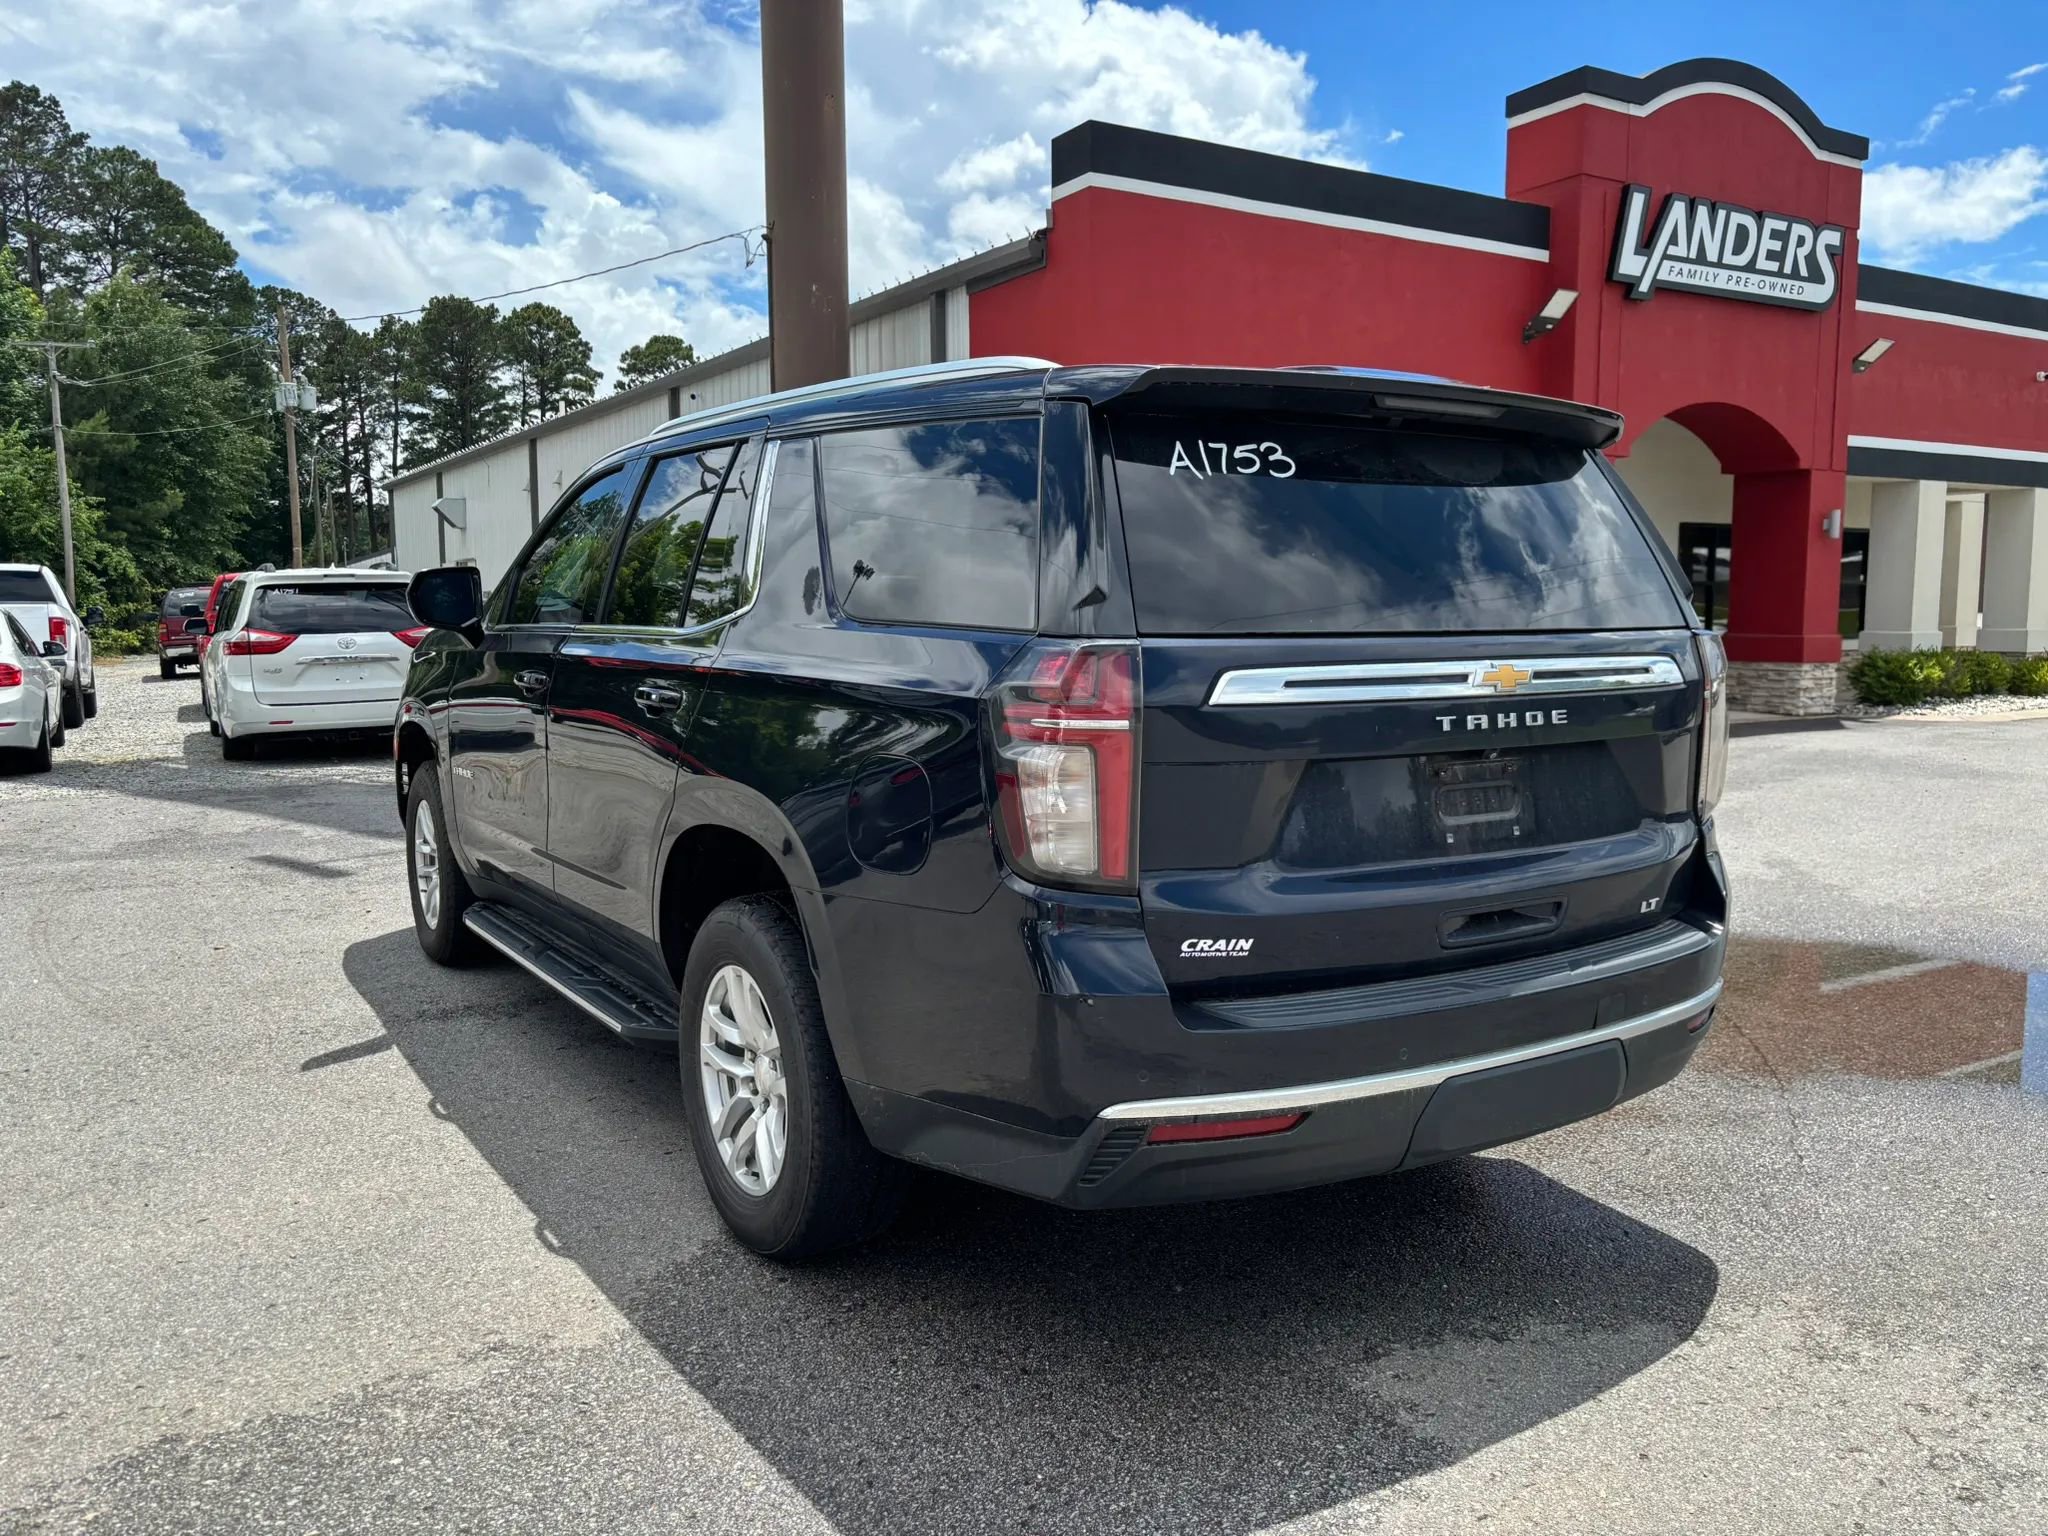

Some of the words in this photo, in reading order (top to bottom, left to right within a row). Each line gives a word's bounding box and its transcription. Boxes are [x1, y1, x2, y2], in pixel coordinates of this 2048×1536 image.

[1618, 191, 1841, 300] LANDERS
[1667, 264, 1720, 284] FAMILY
[1726, 274, 1805, 296] PRE-OWNED
[1169, 439, 1297, 480] A1753
[1435, 709, 1569, 732] TAHOE
[1640, 897, 1661, 914] LT
[1181, 938, 1254, 951] CRAIN
